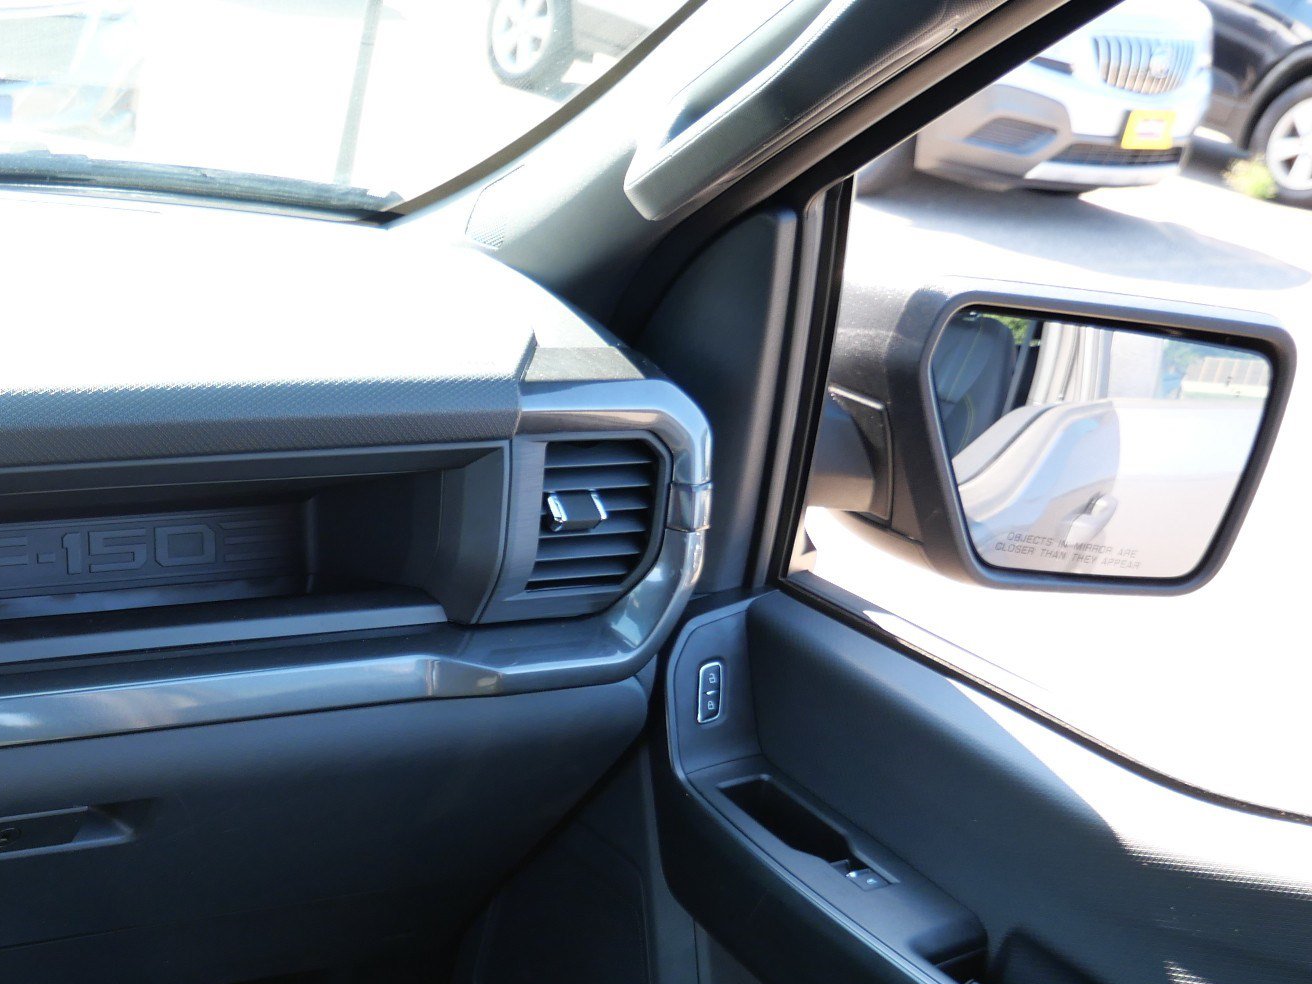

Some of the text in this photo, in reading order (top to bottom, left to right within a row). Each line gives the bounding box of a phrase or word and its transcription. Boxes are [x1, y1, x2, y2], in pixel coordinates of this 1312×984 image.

[994, 541, 1035, 556] CLOSER
[1040, 548, 1067, 560] THAN
[1072, 553, 1098, 564] THEY
[1007, 532, 1054, 547] OBJECTS
[1073, 542, 1113, 554] MIRROR
